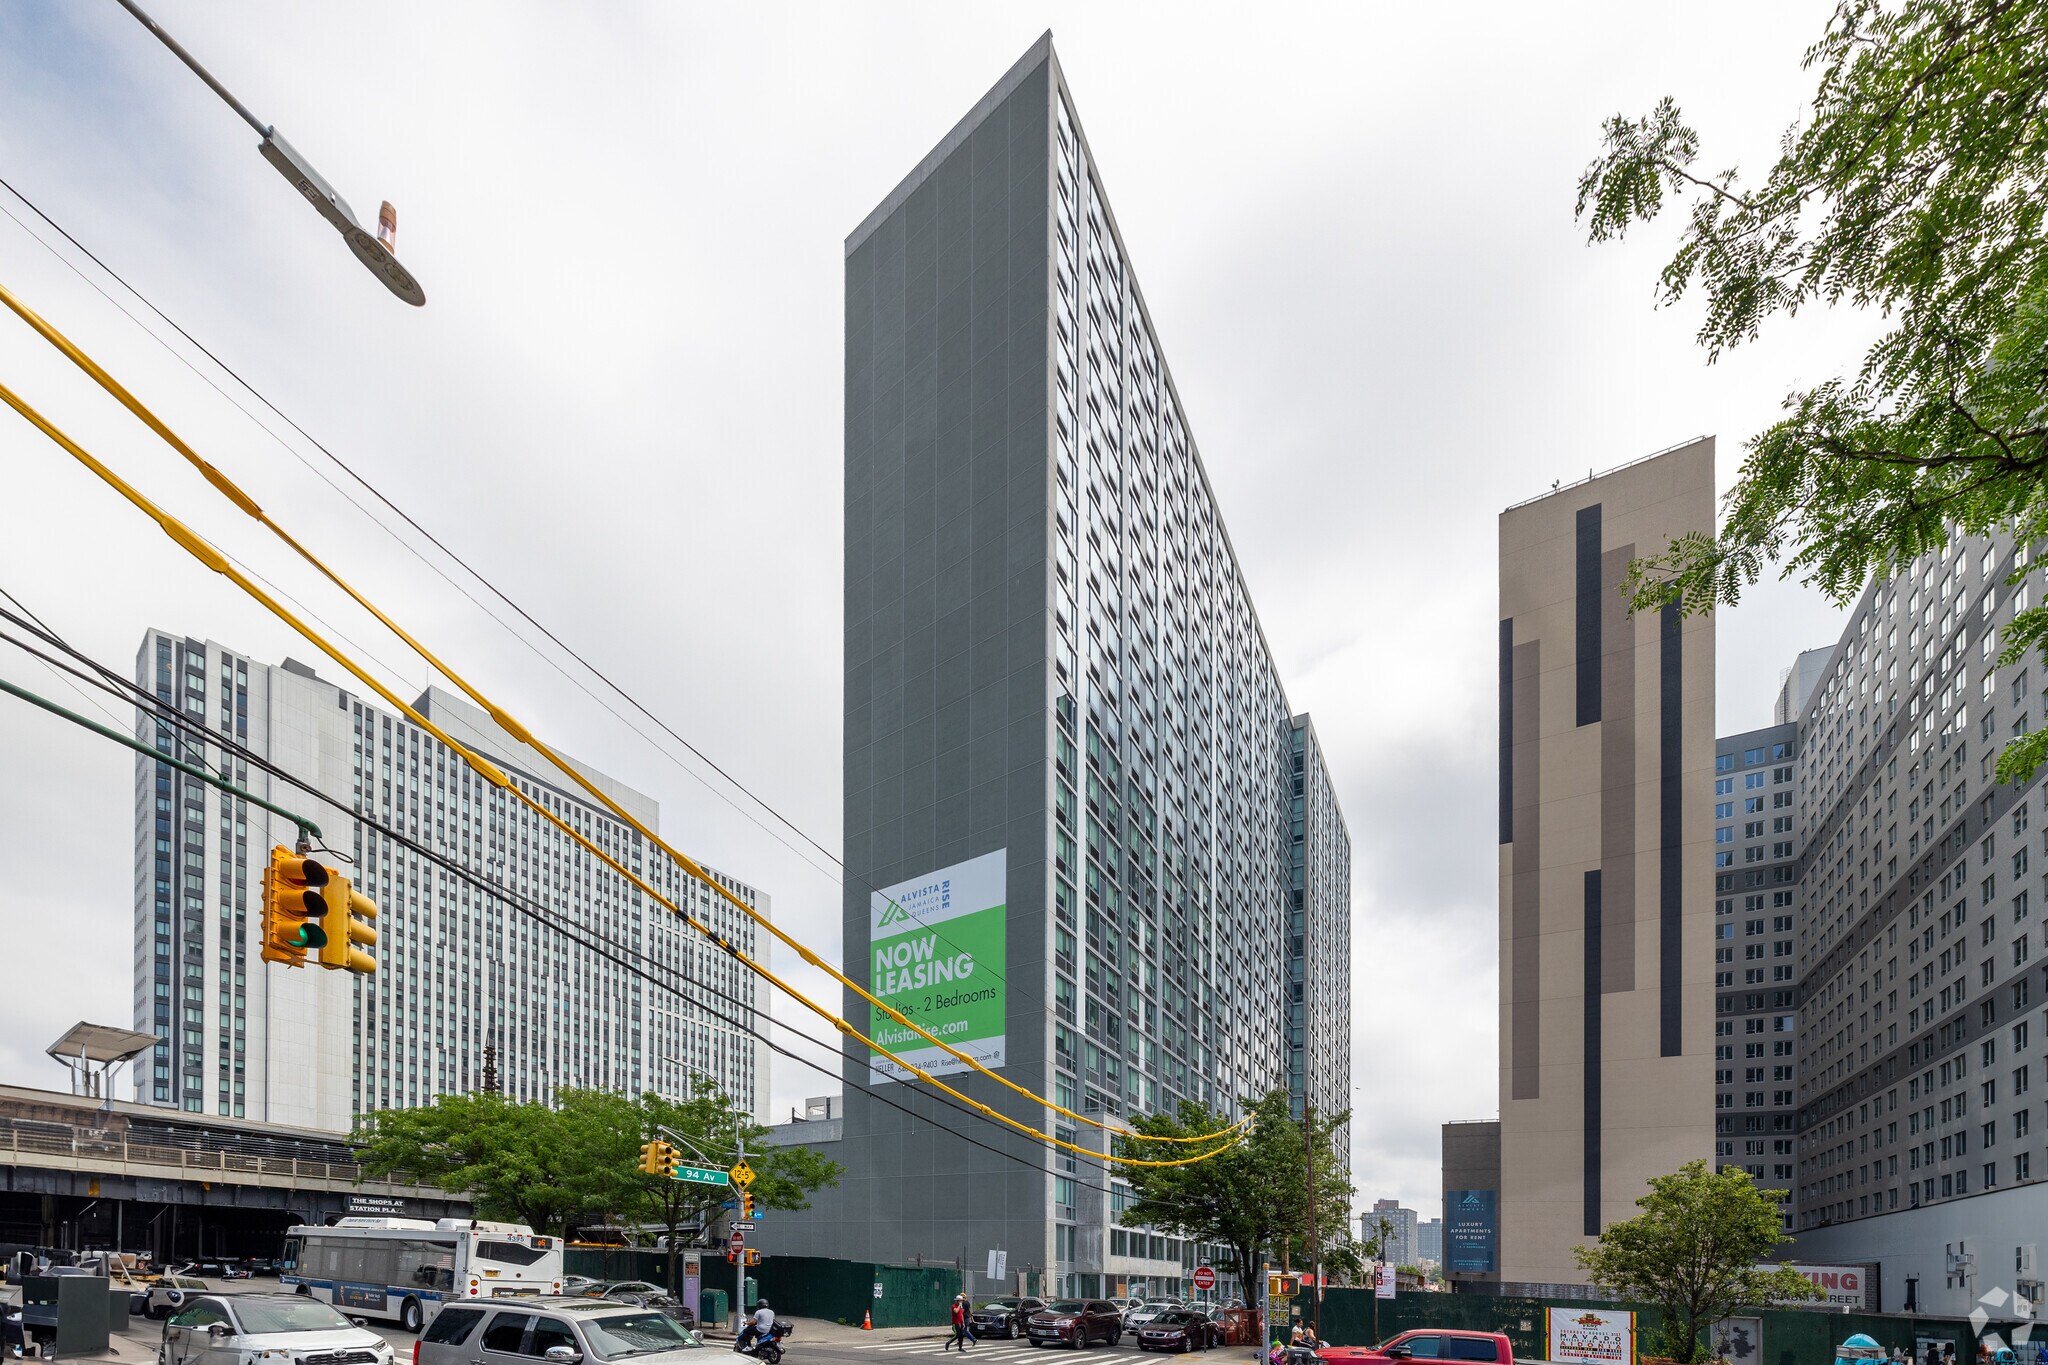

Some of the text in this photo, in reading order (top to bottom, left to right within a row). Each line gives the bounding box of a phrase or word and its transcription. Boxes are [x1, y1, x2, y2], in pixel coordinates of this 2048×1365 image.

[901, 884, 939, 903] ALVISTA
[942, 880, 950, 909] RISE
[908, 896, 939, 910] JAMAICA
[912, 904, 939, 917] QUEENS
[876, 934, 937, 972] NOW
[875, 953, 974, 997] LEASING
[924, 996, 932, 1012] 2
[936, 988, 996, 1009] Bedrooms
[686, 1170, 715, 1181] 94 Av
[1560, 1333, 1622, 1341] MAVADO
[1560, 1341, 1622, 1350] AIDONIA
